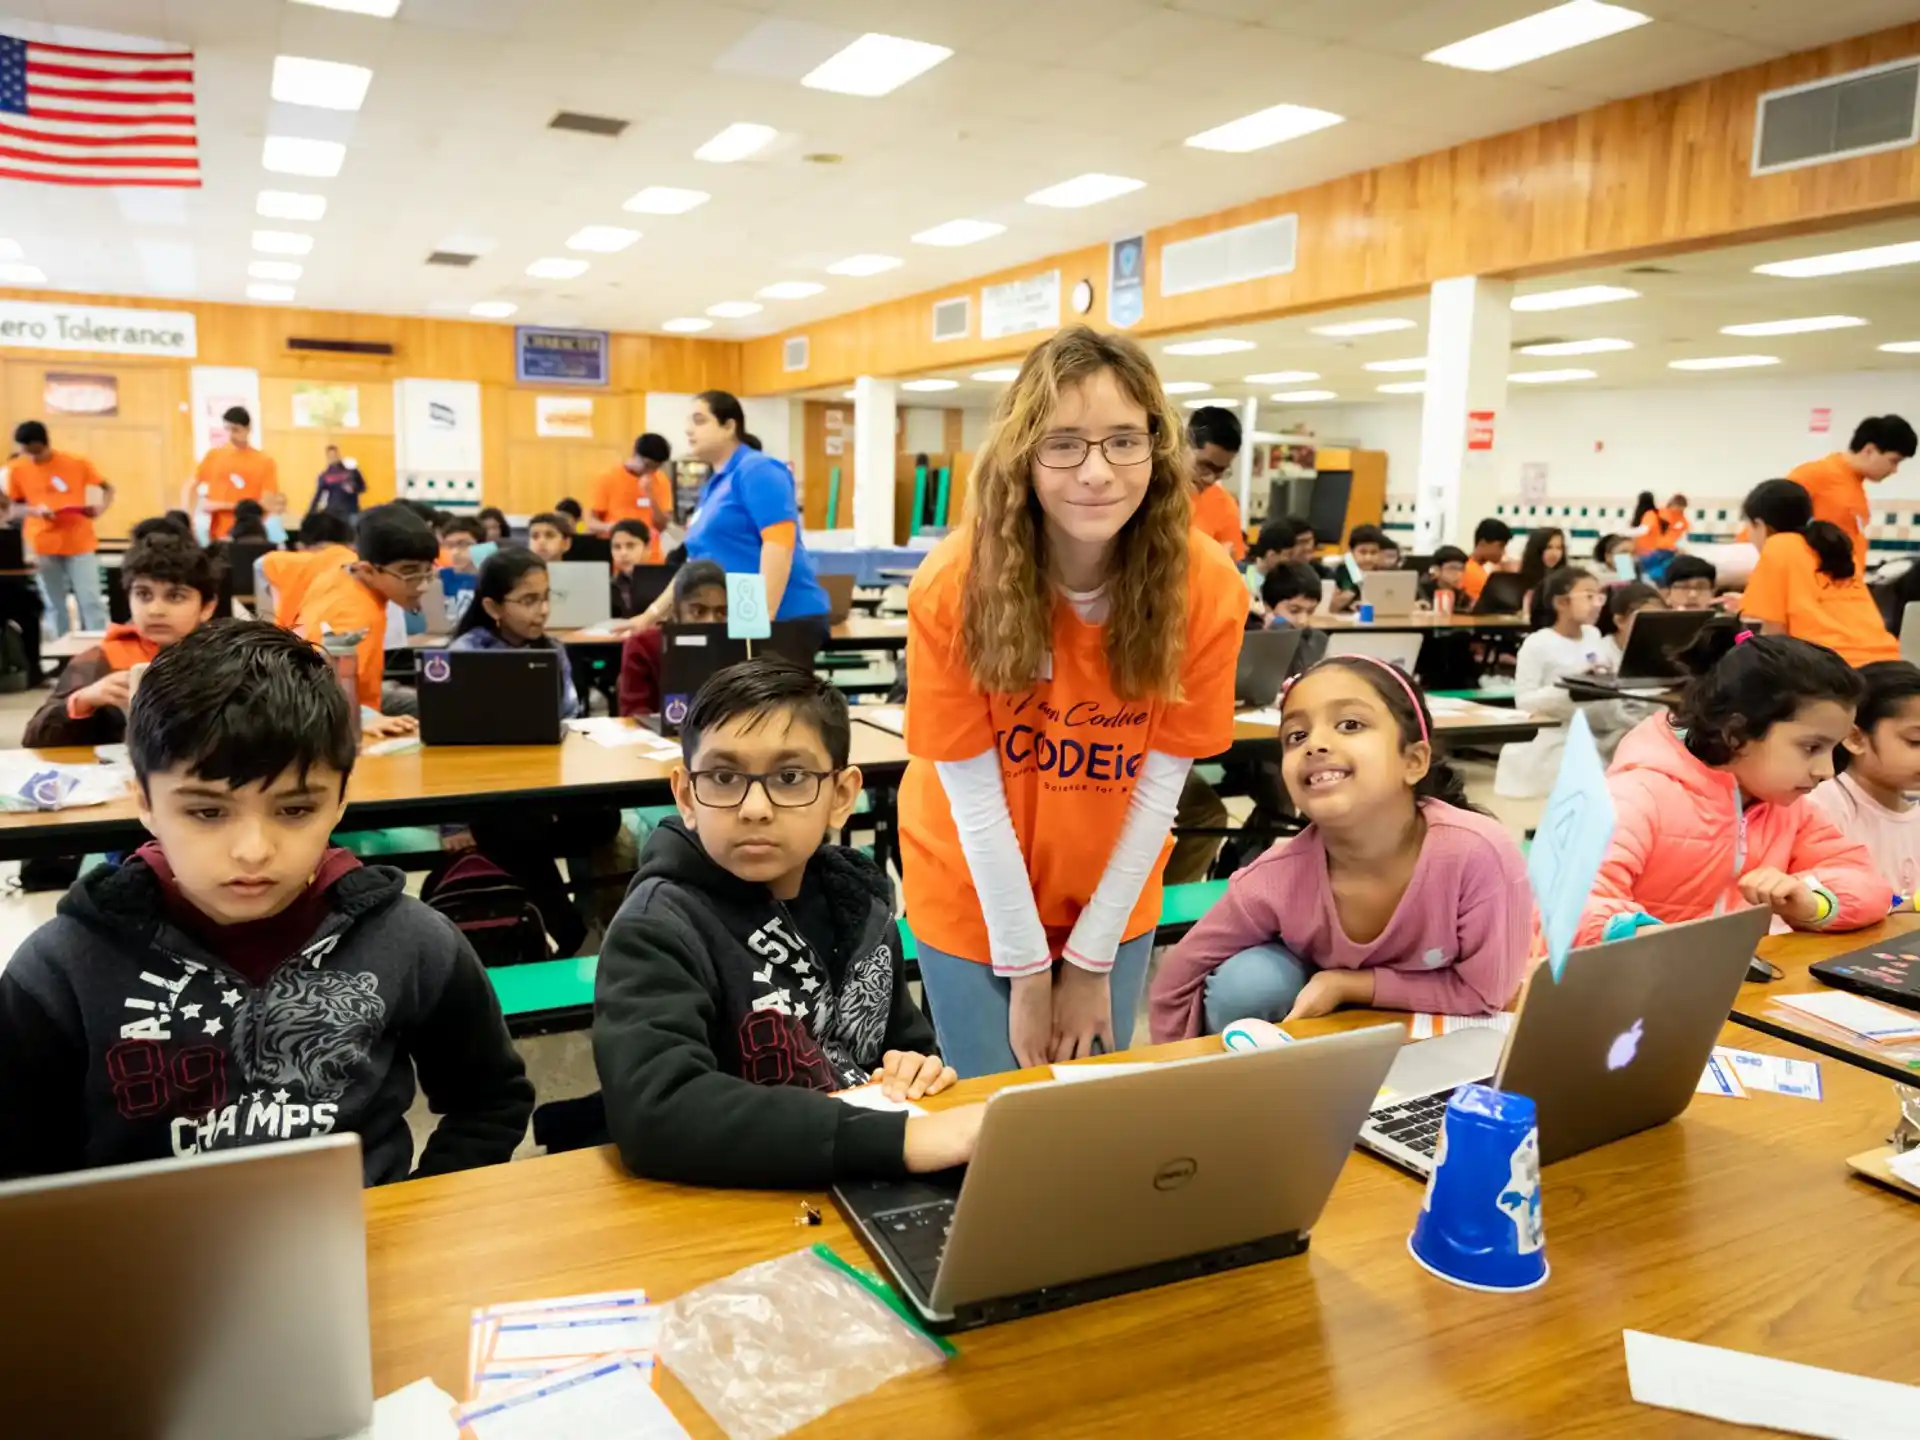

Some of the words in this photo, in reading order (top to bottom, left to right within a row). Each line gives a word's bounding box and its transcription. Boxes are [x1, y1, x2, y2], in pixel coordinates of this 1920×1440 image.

[54, 314, 185, 347] Tolerance
[105, 1038, 227, 1120] 89
[170, 1101, 339, 1158] CHAMPS
